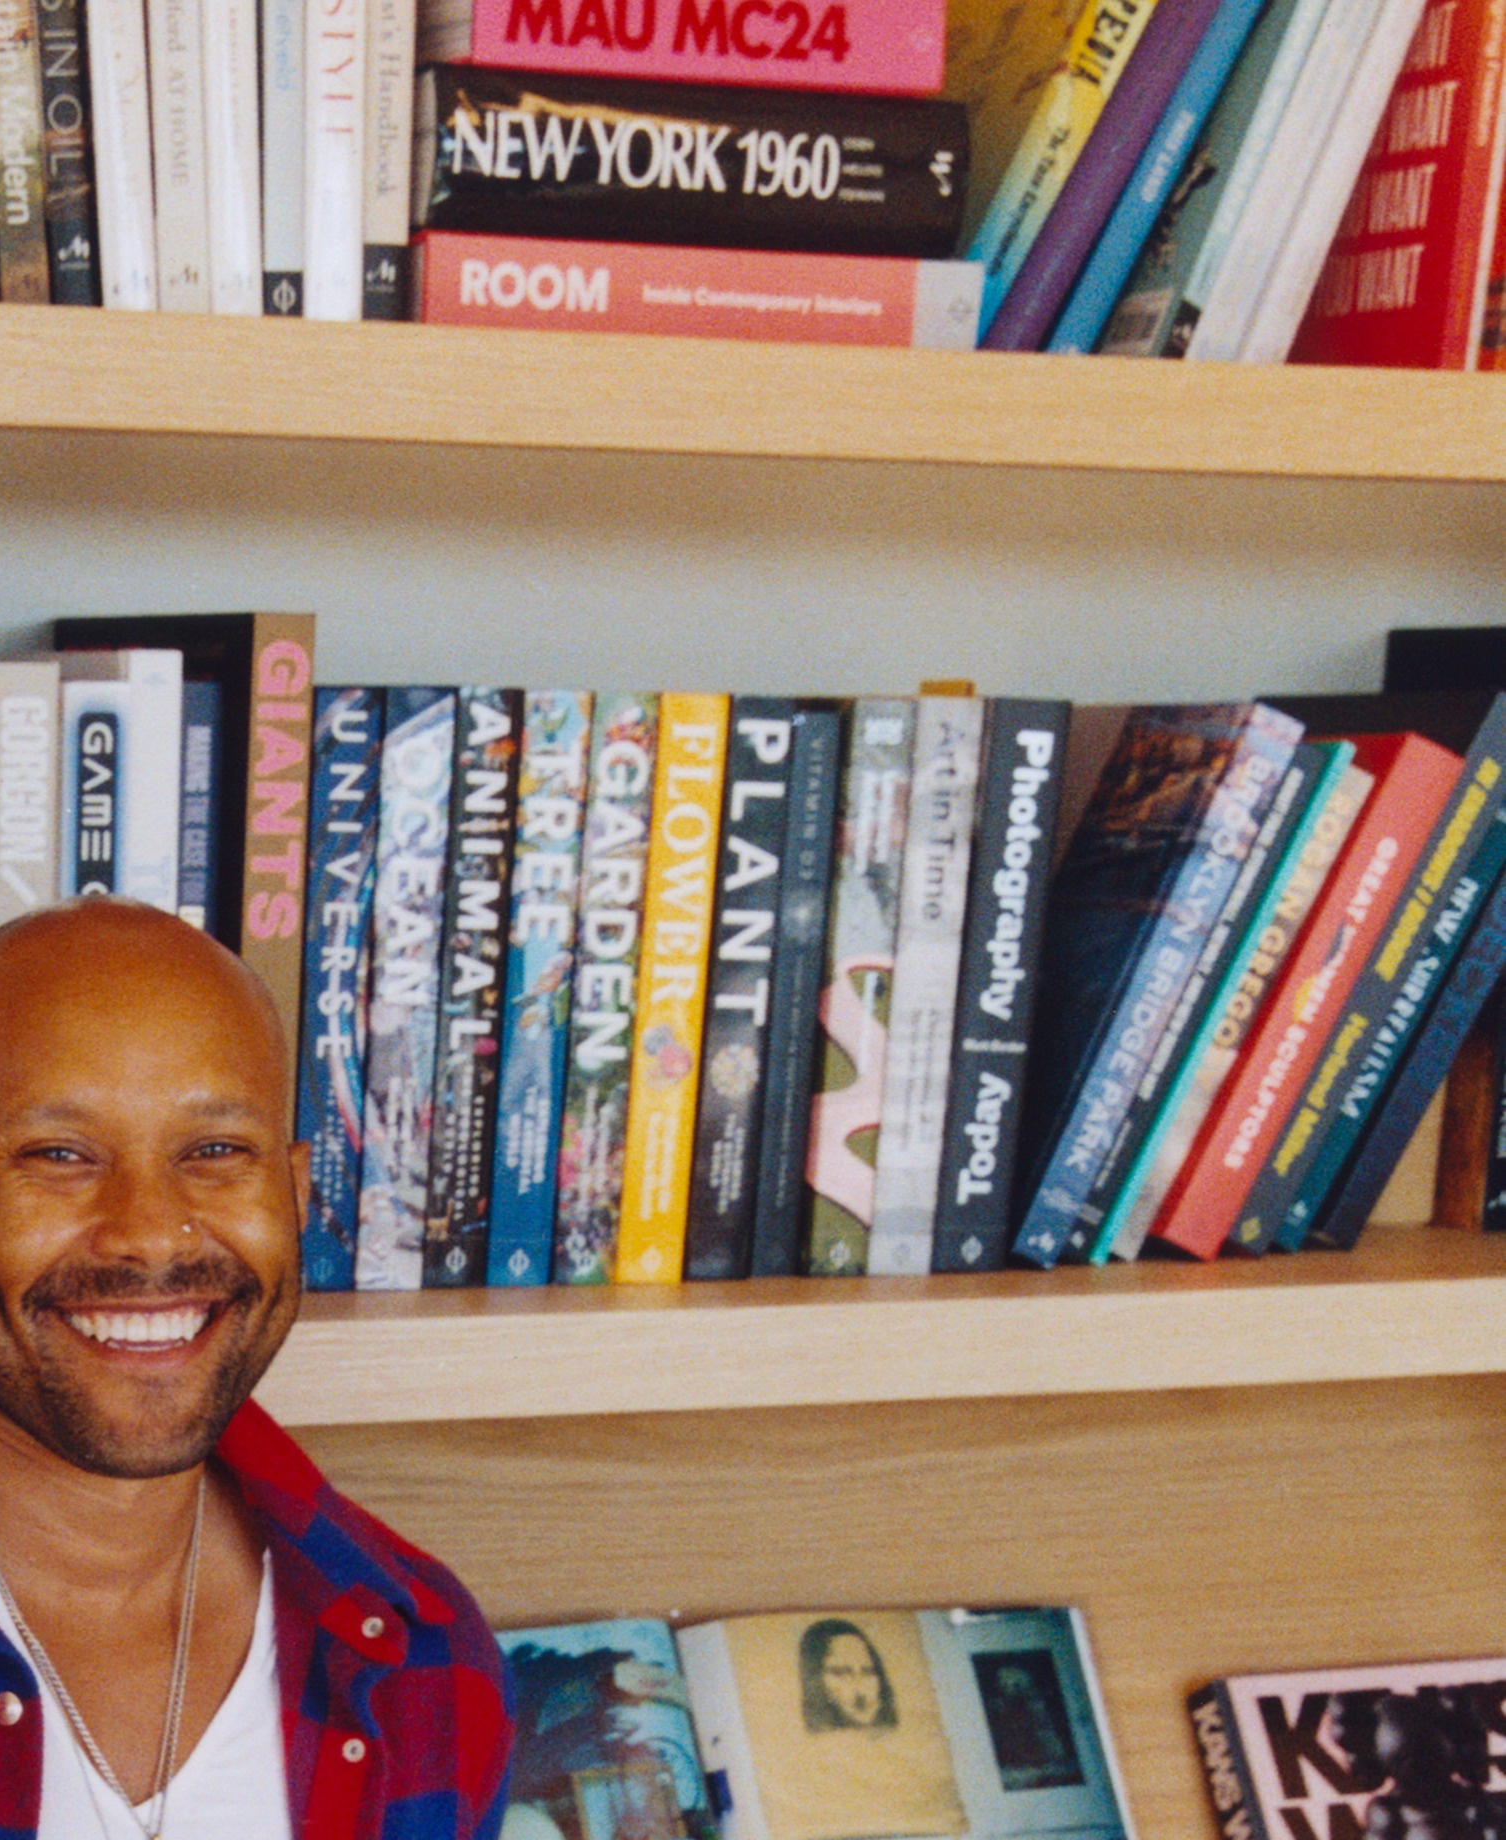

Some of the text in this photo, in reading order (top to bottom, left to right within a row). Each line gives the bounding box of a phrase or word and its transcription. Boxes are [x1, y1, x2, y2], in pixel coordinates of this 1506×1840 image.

[504, 0, 851, 63] MAU MC24
[452, 106, 583, 183] NEW
[589, 114, 734, 194] YORK
[737, 130, 840, 200] 1960
[460, 259, 611, 314] ROOM
[81, 722, 114, 863] GAME
[247, 640, 310, 940] GIANTS
[382, 733, 445, 1006] OCEAN
[447, 700, 512, 1049] ANIMAL
[515, 741, 583, 946] TREE
[650, 719, 718, 1005] FLOWER
[713, 719, 792, 1028] PLANT
[981, 728, 1056, 1022] Photography
[1166, 750, 1275, 948] BROOKLYN
[315, 711, 369, 1060] UNIVERSE
[574, 739, 650, 1070] GARDEN
[920, 836, 964, 922] Time
[1342, 832, 1401, 924] GREAT
[1105, 943, 1185, 1082] BRIDGE
[1219, 1023, 1307, 1172] SCULPTORS
[957, 1073, 1012, 1206] Today
[1062, 1076, 1124, 1176] PARK
